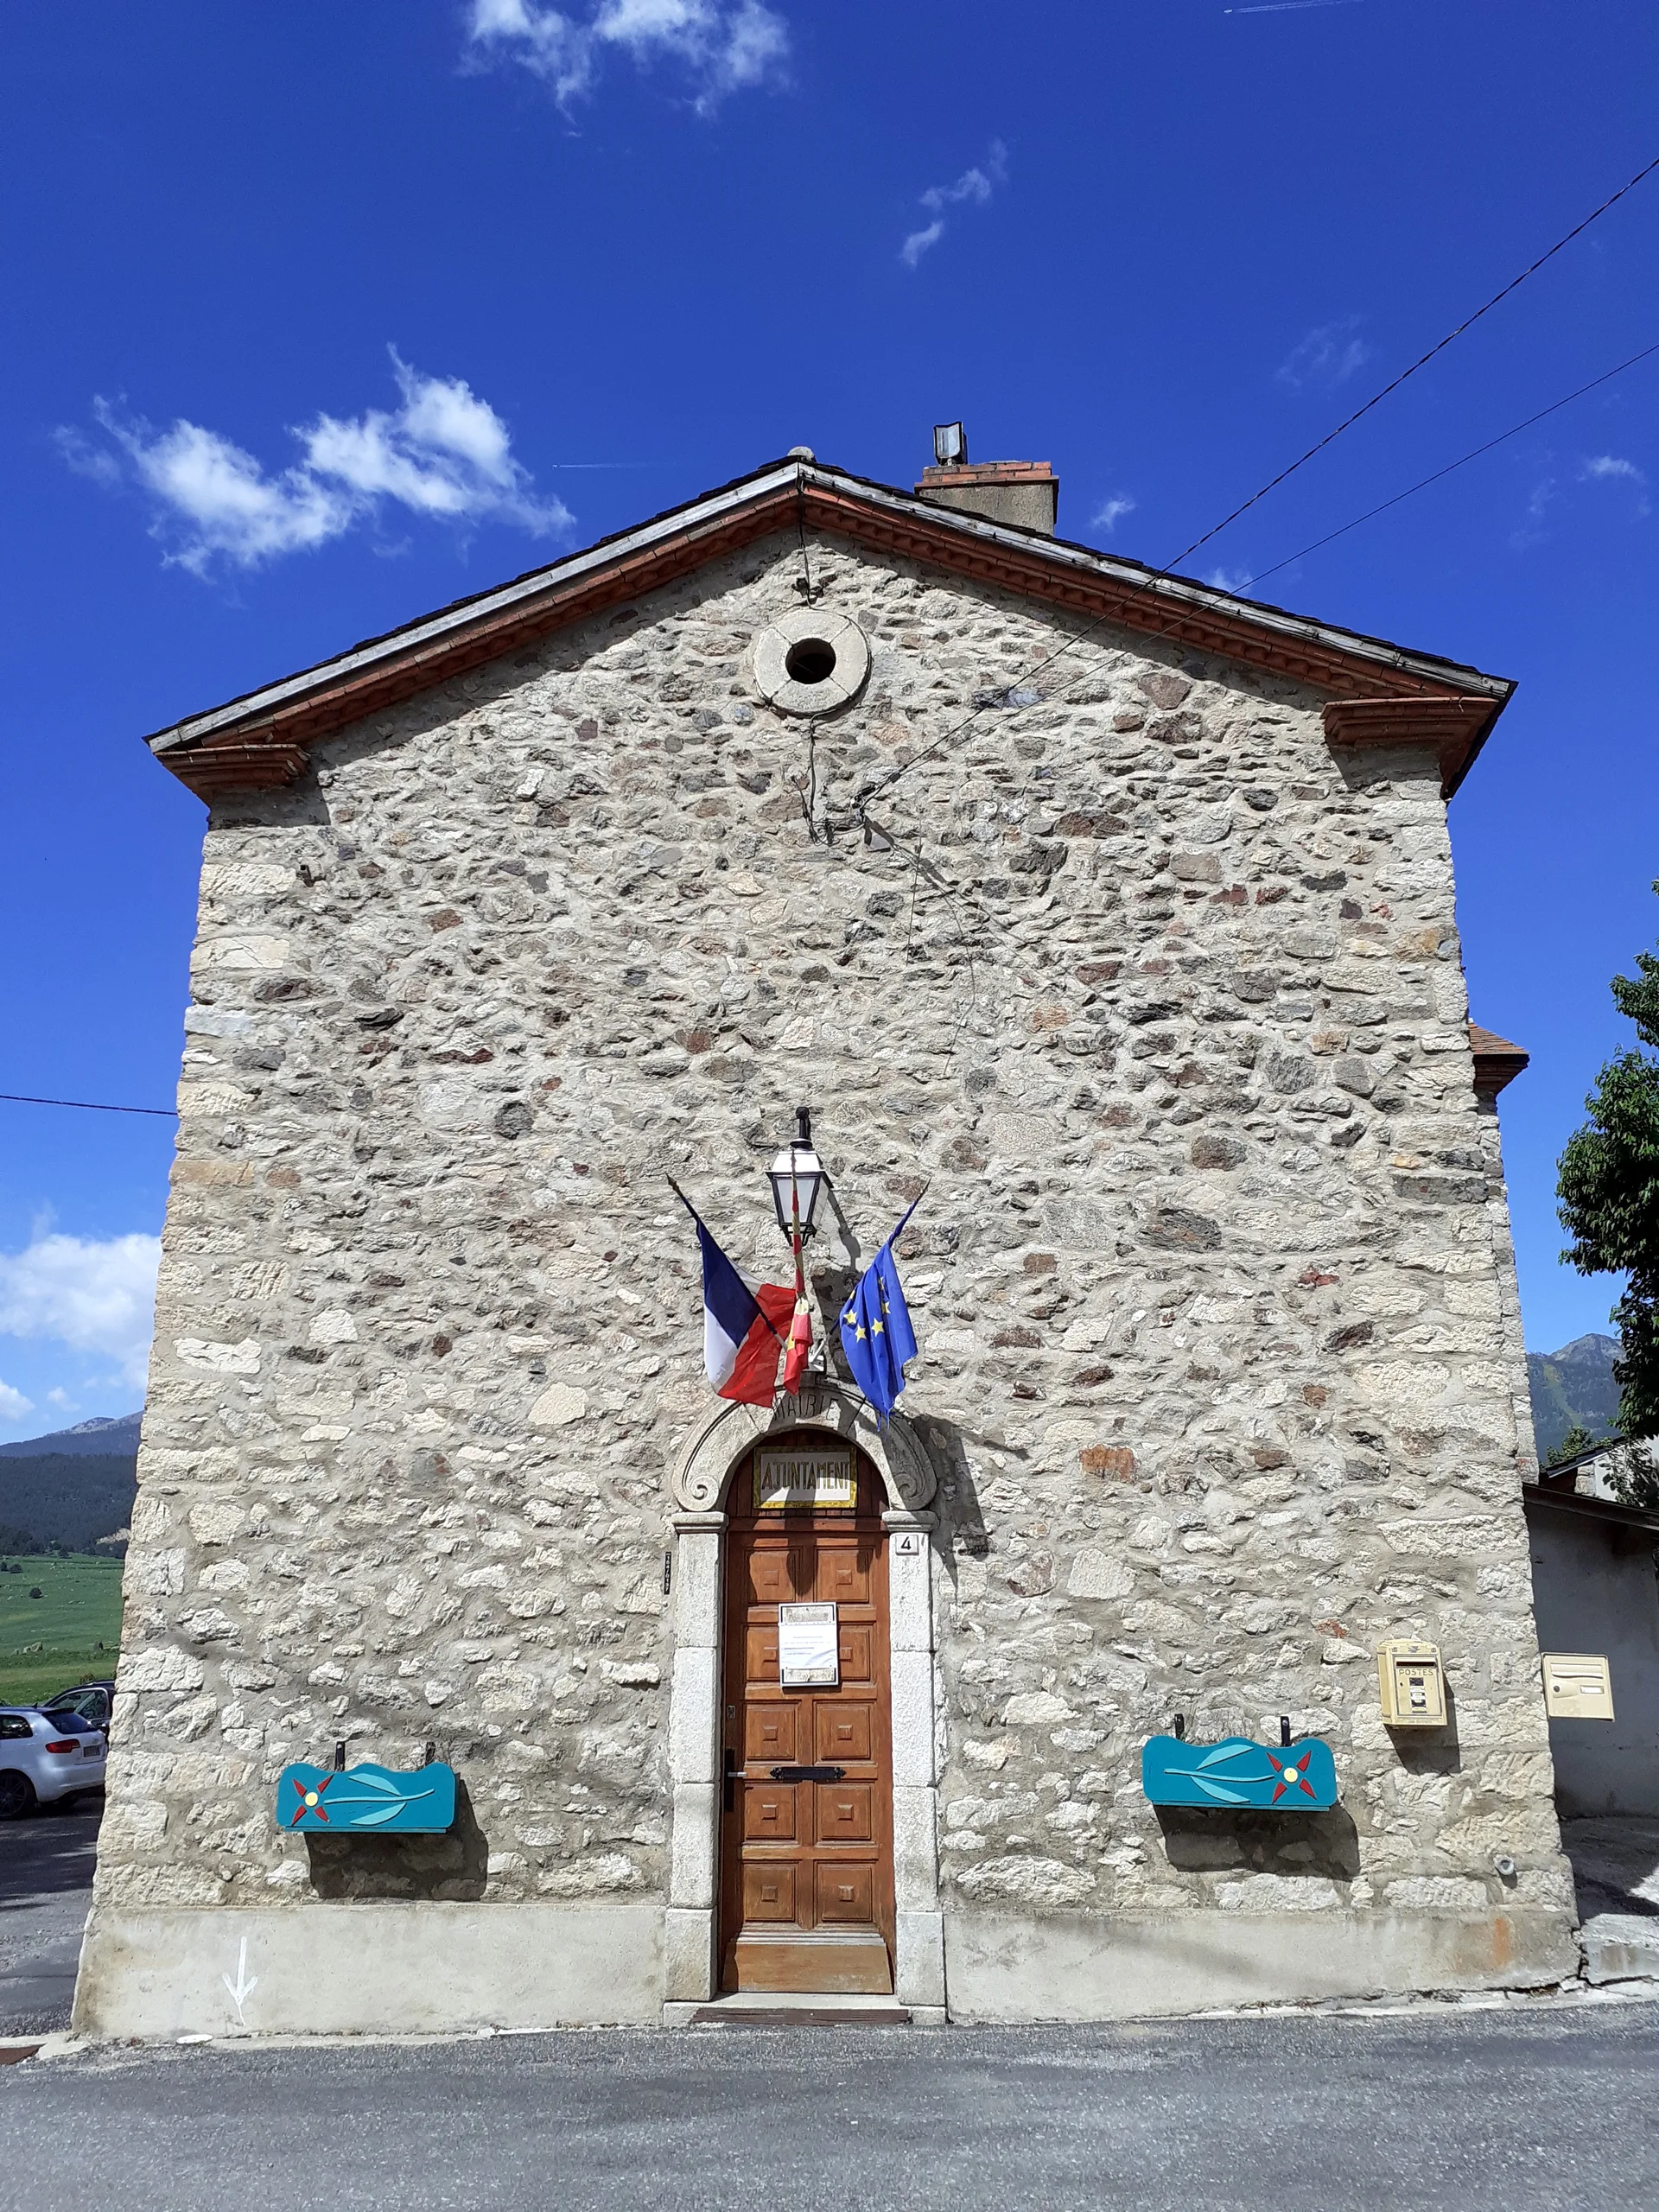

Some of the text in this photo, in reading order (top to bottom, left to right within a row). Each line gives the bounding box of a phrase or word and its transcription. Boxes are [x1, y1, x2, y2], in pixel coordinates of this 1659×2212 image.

[773, 1394, 839, 1421] MAIRIE
[761, 1460, 850, 1491] AJUNTAMENT
[900, 1536, 912, 1550] 4
